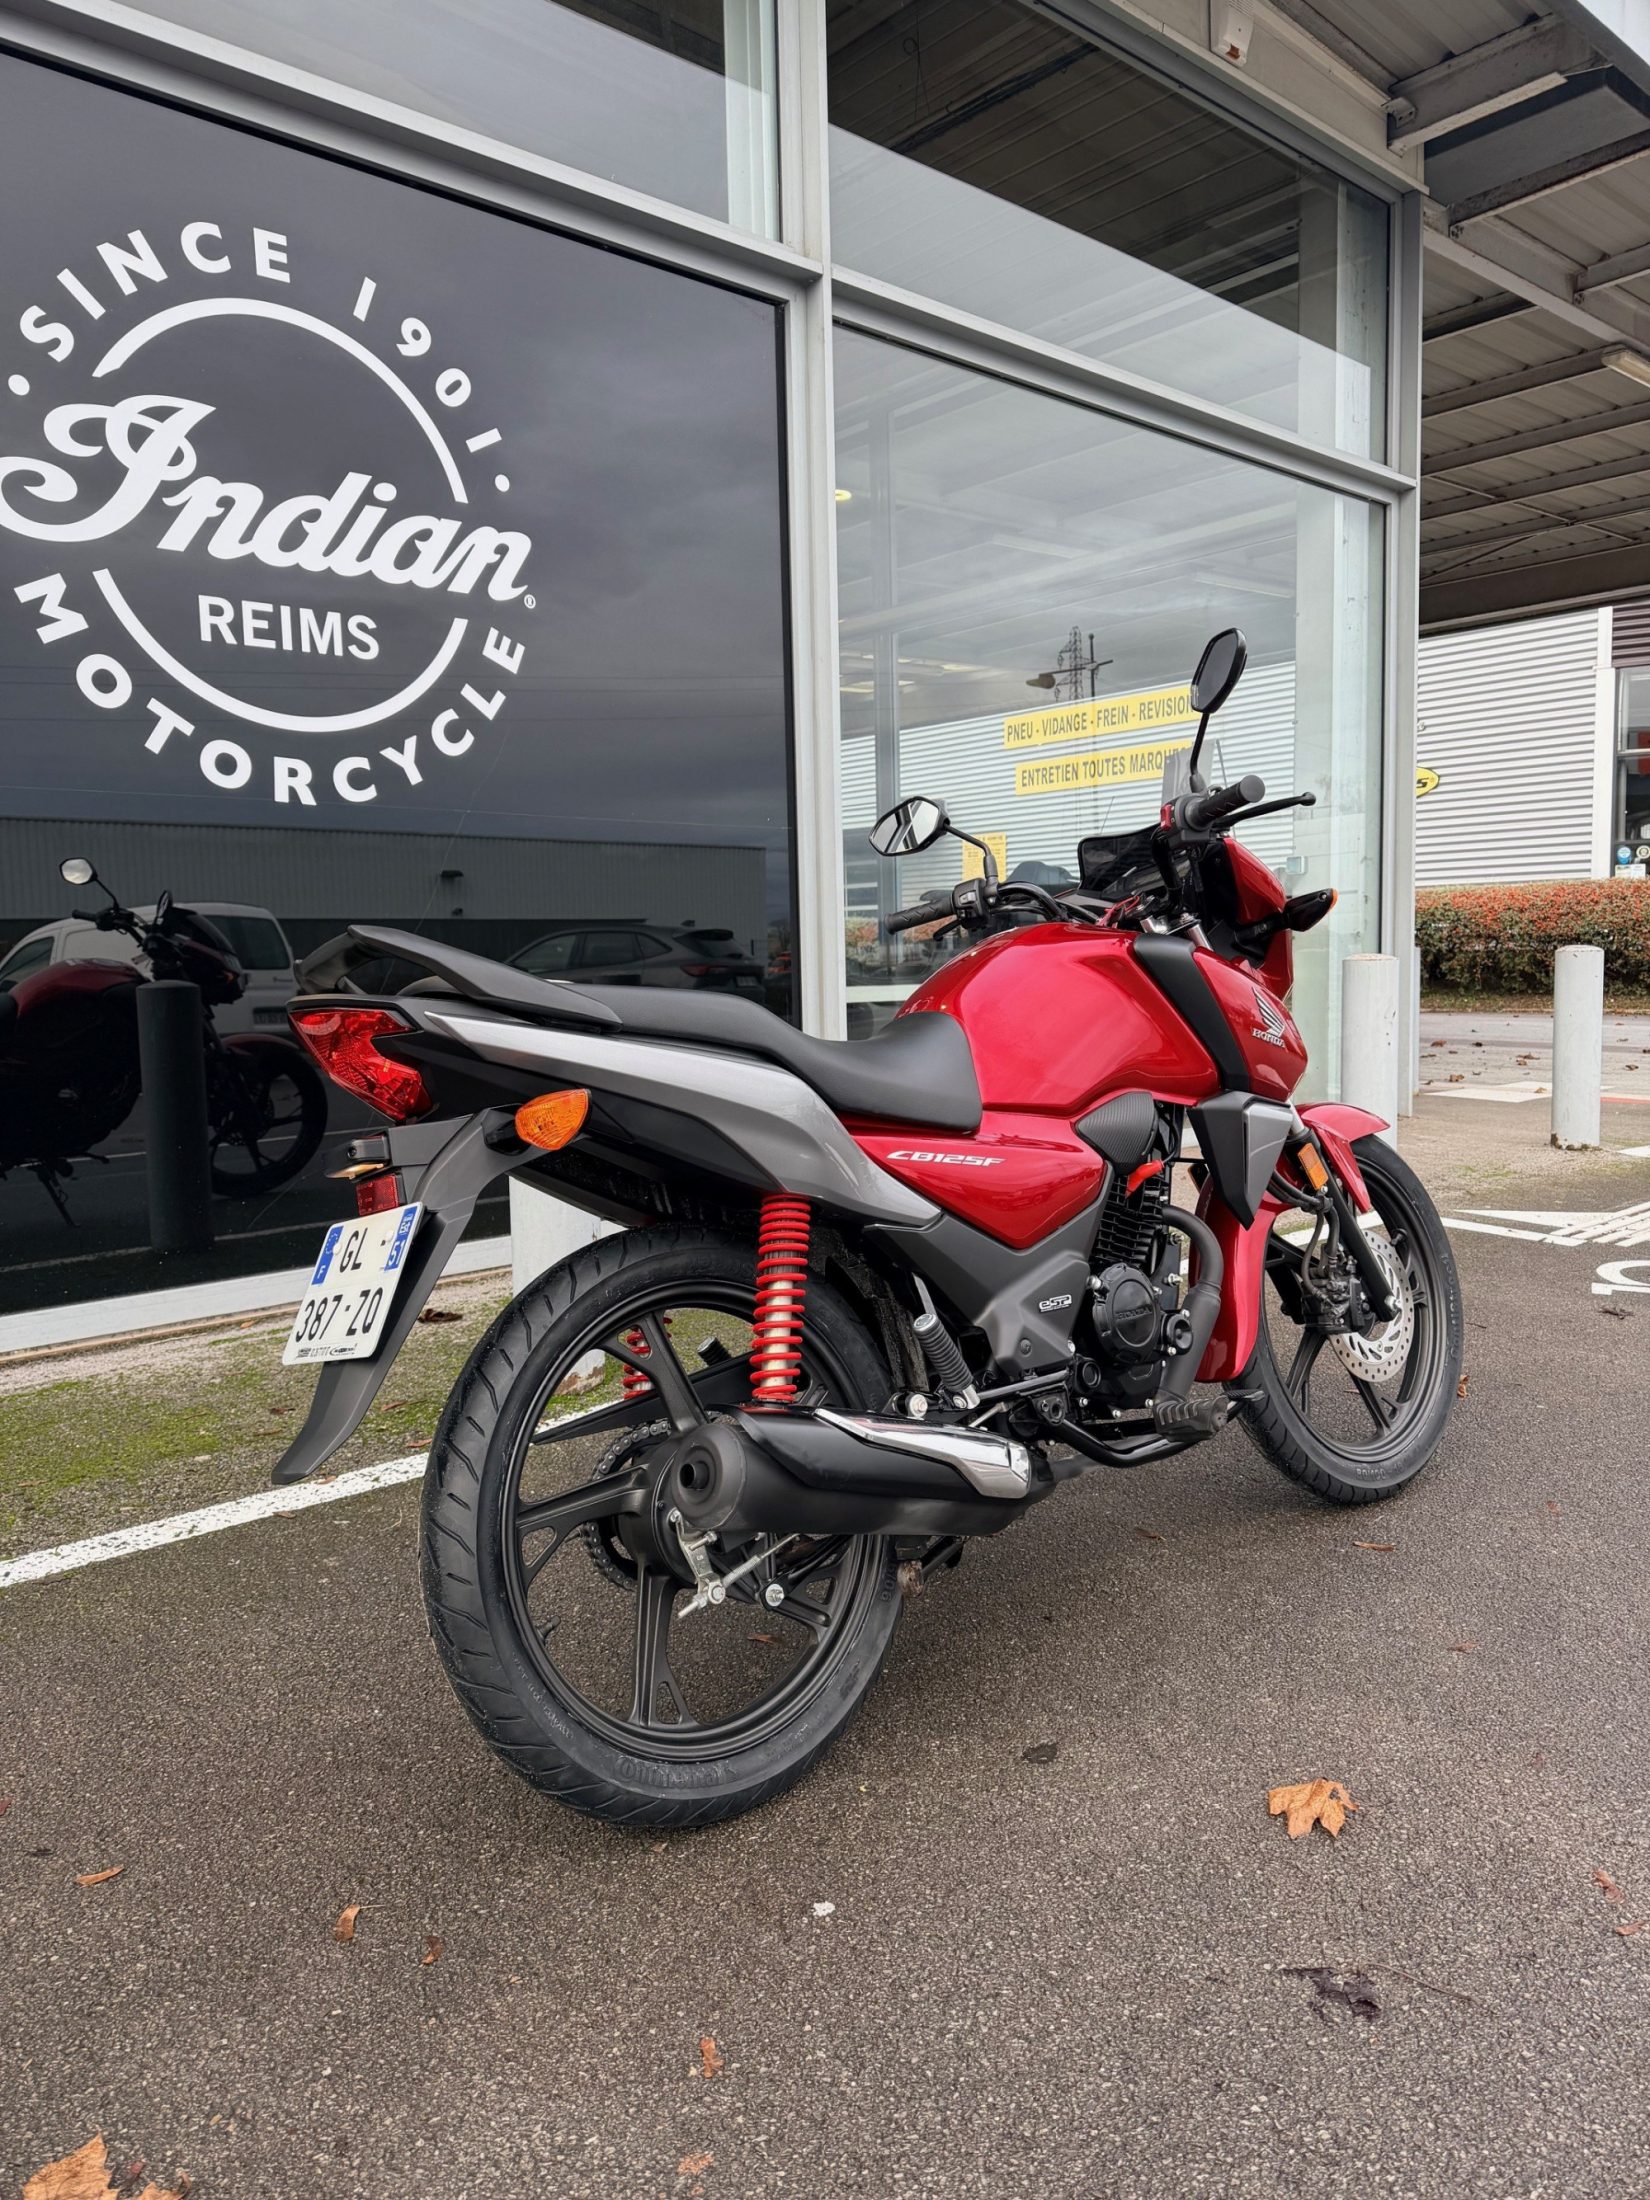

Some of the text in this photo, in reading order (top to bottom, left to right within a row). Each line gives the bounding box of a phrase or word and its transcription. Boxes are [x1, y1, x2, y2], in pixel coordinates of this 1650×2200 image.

[20, 222, 291, 362] SINCE
[198, 595, 380, 661] REIMS
[14, 572, 526, 806] MOTORCYCLE
[1007, 720, 1033, 742] PNEU
[1042, 712, 1088, 737] VIDANGE
[1097, 705, 1129, 728] FREIN
[1021, 763, 1079, 788] ENTRETIEN
[1082, 756, 1126, 779] TOUTES
[886, 1150, 1007, 1167] CB125F
[339, 1227, 368, 1273] GL
[317, 1264, 326, 1280] F
